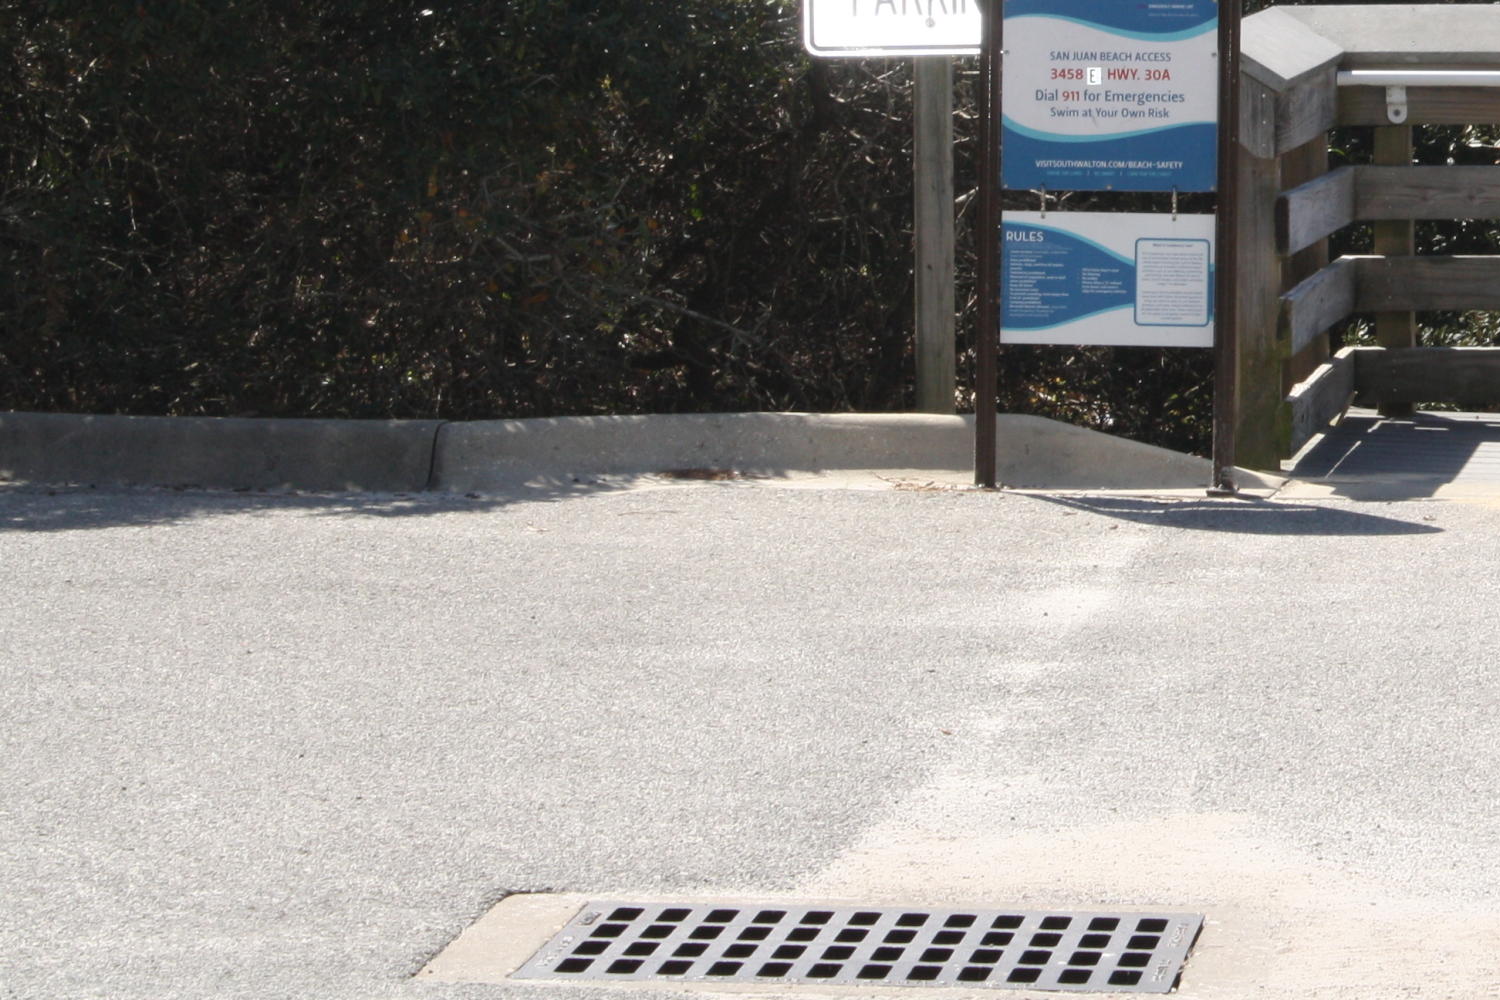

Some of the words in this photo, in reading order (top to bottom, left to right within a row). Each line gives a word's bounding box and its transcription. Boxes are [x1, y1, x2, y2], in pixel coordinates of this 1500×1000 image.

[1050, 51, 1069, 61] SAN
[1072, 51, 1097, 61] JUAN
[1100, 51, 1132, 62] BEACH
[1134, 52, 1171, 62] ACCESS
[1050, 68, 1083, 80] 3458
[1107, 68, 1140, 81] HWY.
[1144, 69, 1171, 81] 30A
[1035, 89, 1059, 102] Dial
[1062, 90, 1080, 102] 911
[1083, 90, 1101, 102] for
[1104, 90, 1185, 106] Emergencies
[1050, 106, 1079, 118] Swim
[1082, 108, 1092, 118] at
[1095, 107, 1118, 118] Your
[1121, 108, 1145, 118] Own
[1148, 107, 1169, 118] Risk
[1035, 160, 1183, 169] VISITSOUTHWALTON.COM/BEACH-SAFETY
[1006, 231, 1044, 242] RULES
